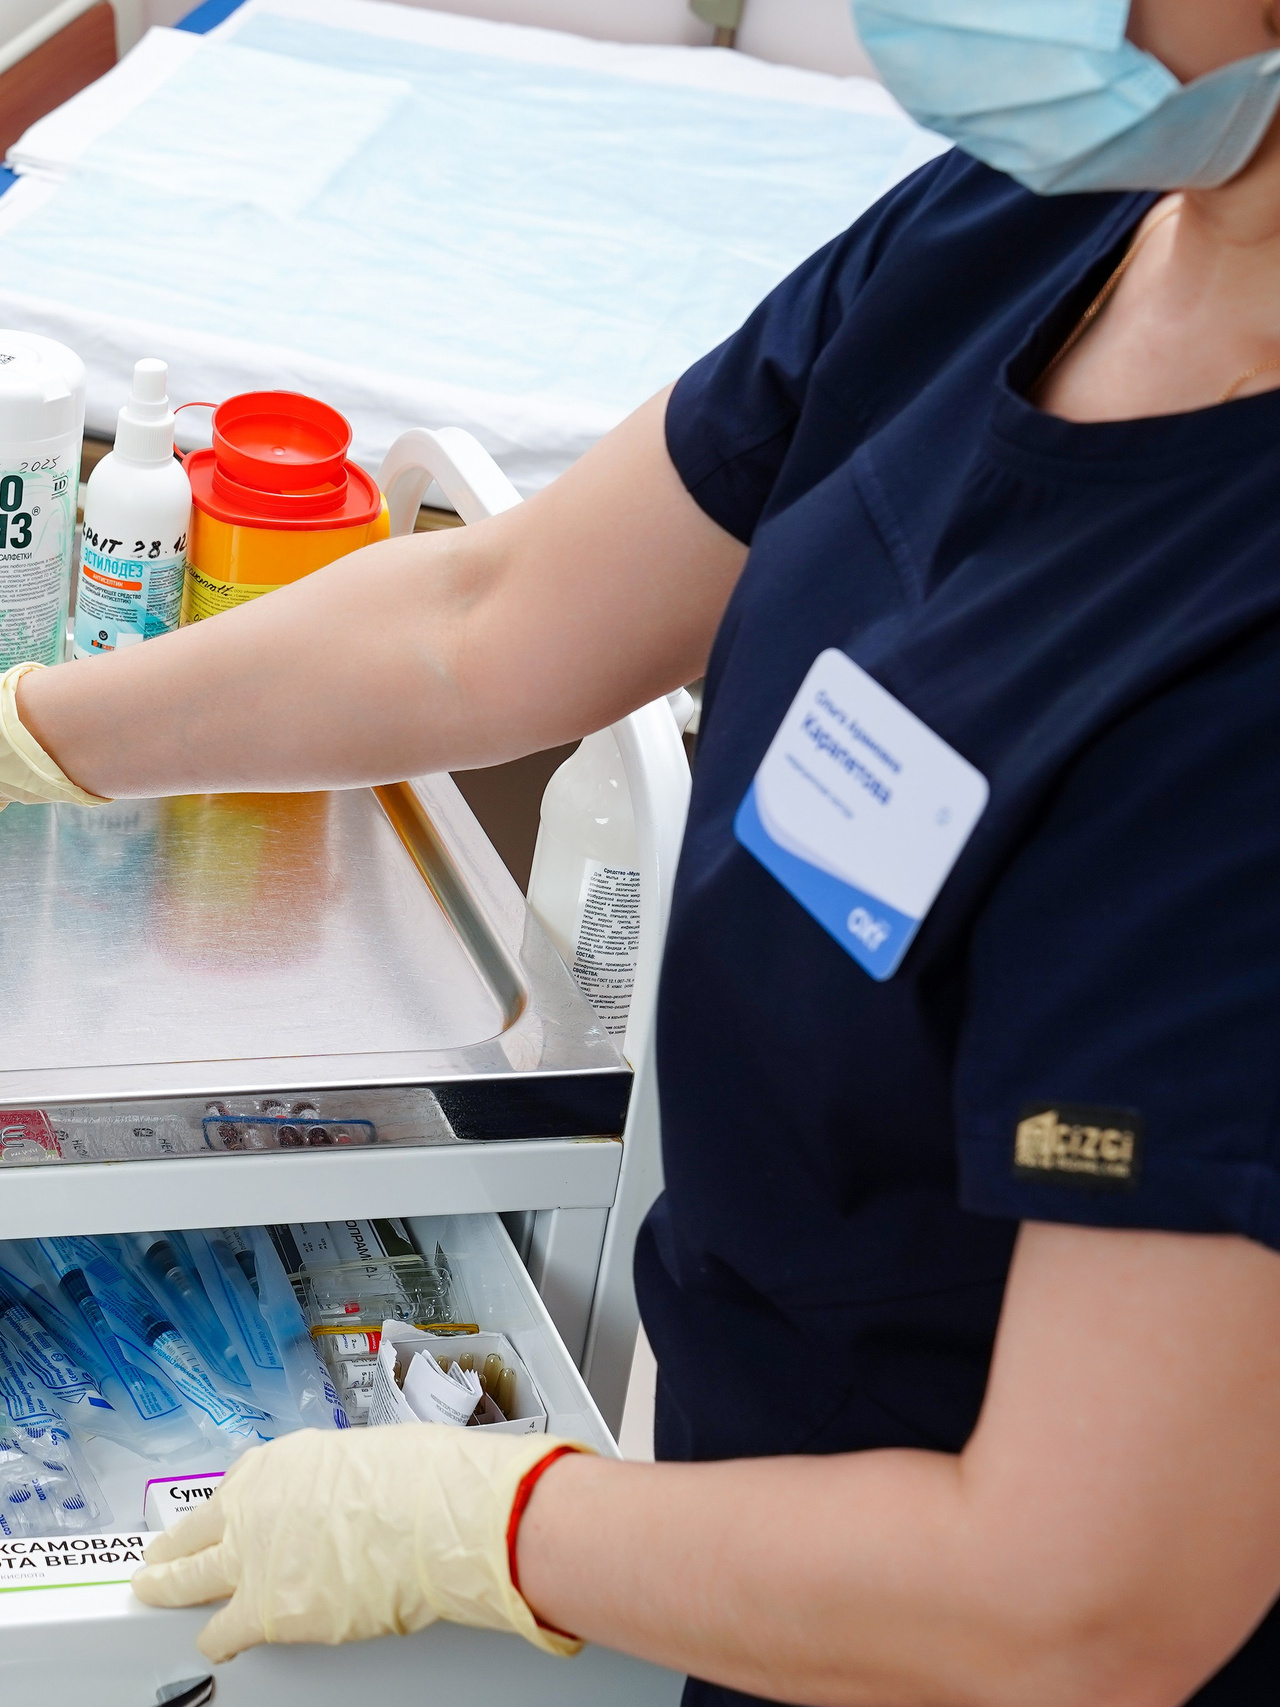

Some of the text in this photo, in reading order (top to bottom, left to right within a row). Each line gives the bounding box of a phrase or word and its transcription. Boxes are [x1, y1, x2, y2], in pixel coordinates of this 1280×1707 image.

[19, 455, 61, 474] 2025
[84, 547, 144, 580] ЭСТИЛОДЕЗ
[529, 1421, 535, 1429] 4
[1, 1571, 46, 1581] кислота
